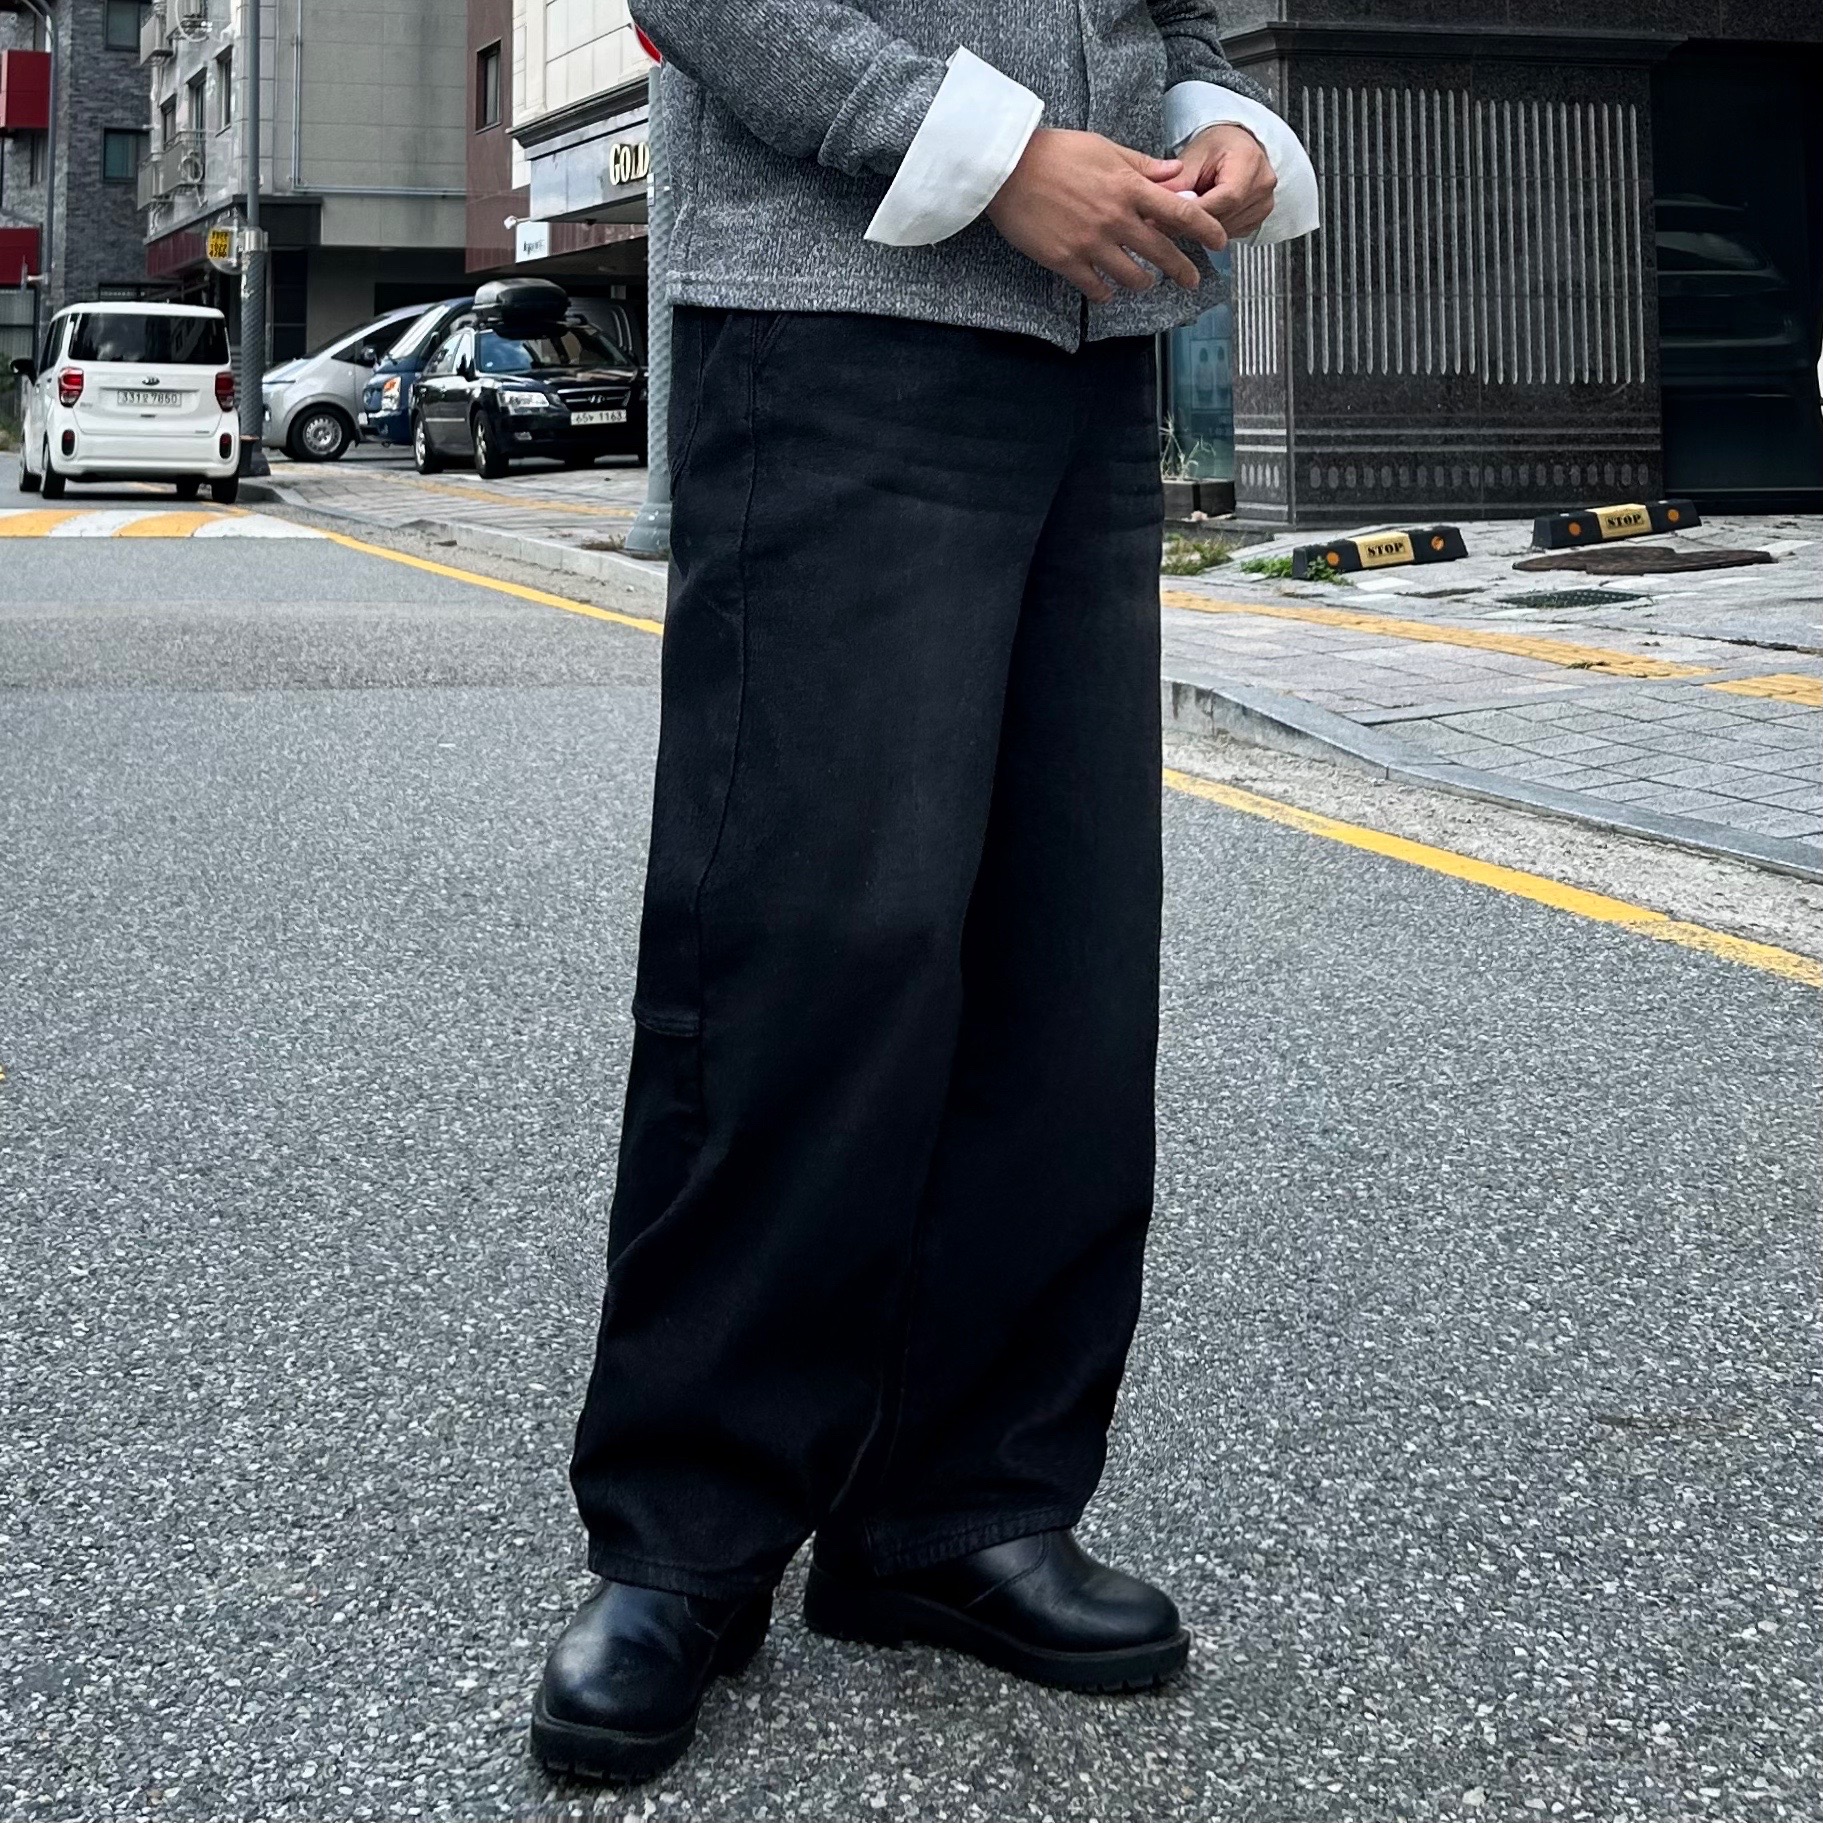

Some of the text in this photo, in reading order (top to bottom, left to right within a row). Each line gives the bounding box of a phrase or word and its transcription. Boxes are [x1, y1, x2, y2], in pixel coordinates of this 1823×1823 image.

[610, 142, 650, 185] GOLD
[1606, 513, 1642, 528] STOP
[1367, 542, 1404, 557] STOP
